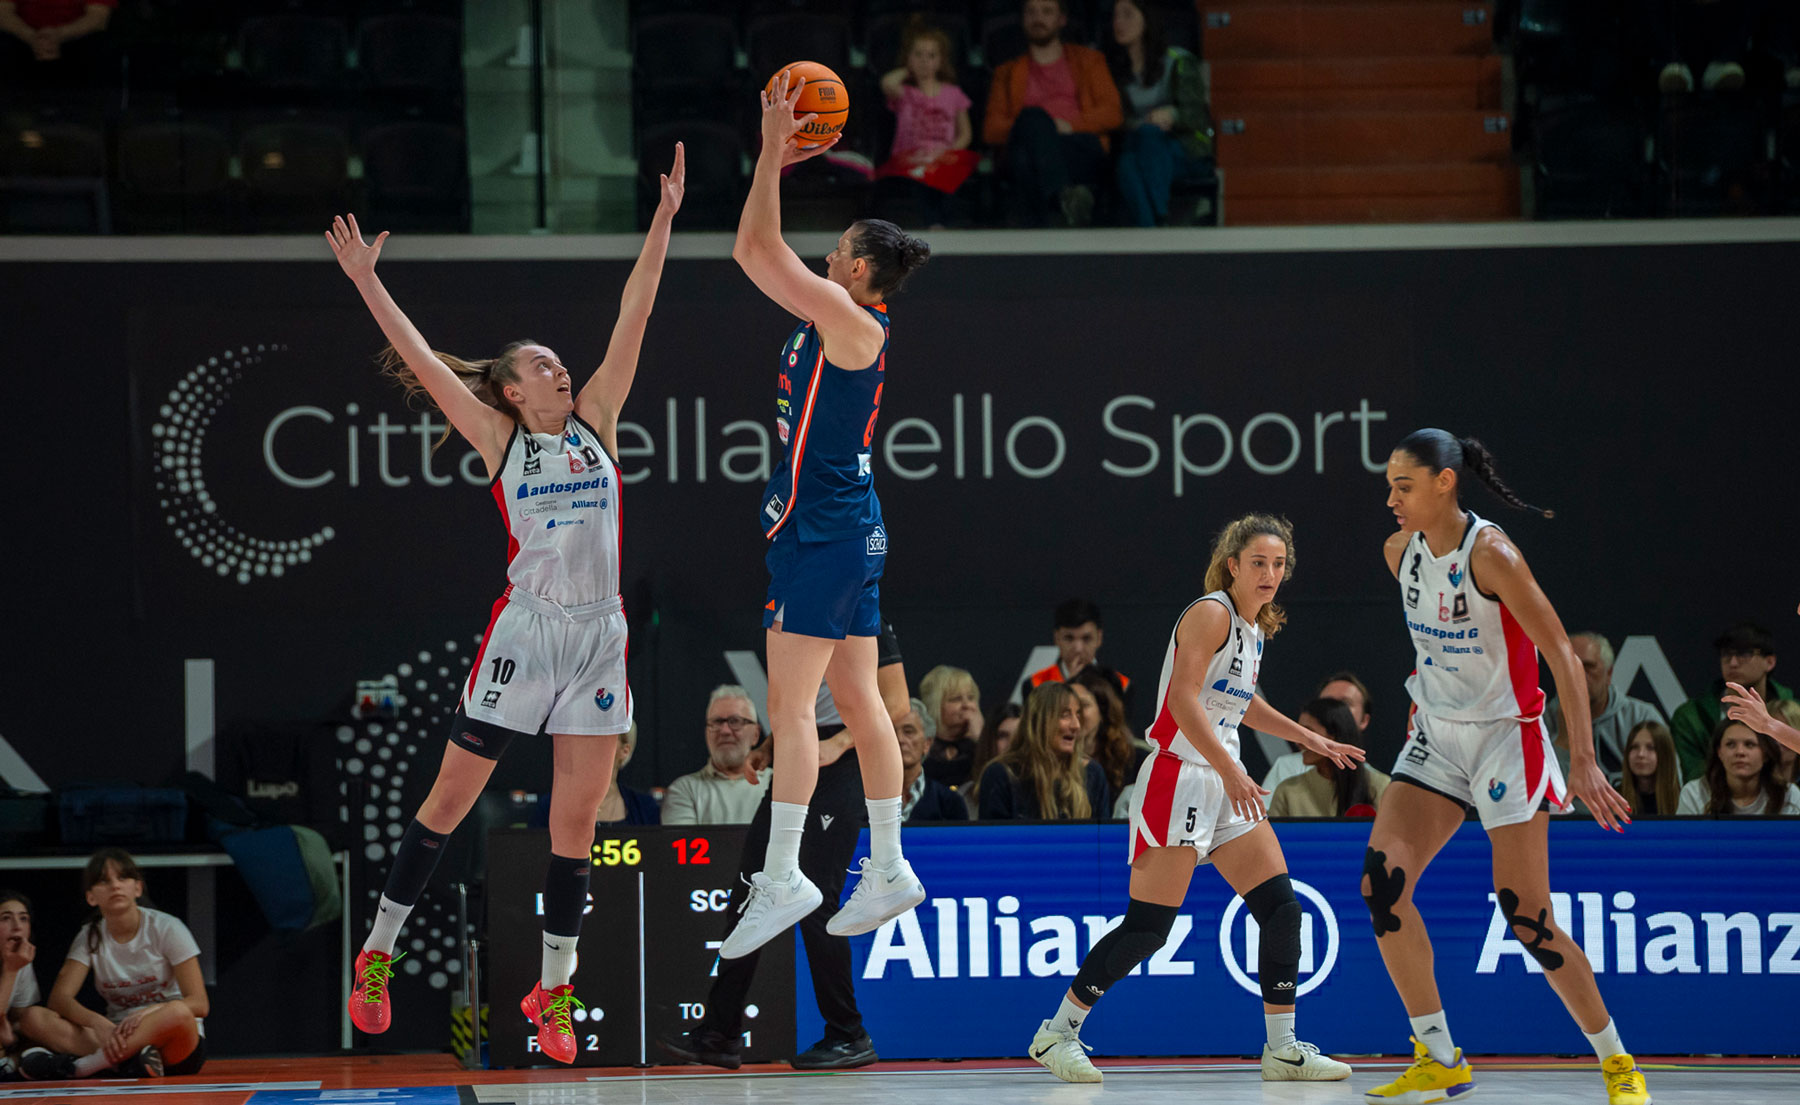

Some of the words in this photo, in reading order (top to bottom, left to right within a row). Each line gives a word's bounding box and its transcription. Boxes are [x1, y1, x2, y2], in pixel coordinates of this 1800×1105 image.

[262, 397, 772, 489] Cittella
[883, 393, 1067, 481] ello
[1102, 395, 1389, 497] Sport
[530, 477, 600, 497] autosped
[601, 476, 609, 489] G
[571, 500, 598, 509] Allianz
[1408, 620, 1465, 640] autosped
[1468, 628, 1479, 638] G
[1442, 645, 1471, 654] Allianz
[491, 656, 516, 686] 10
[1226, 686, 1254, 702] autosp
[1185, 806, 1198, 833] 5
[590, 839, 642, 866] :56
[671, 837, 711, 865] 12
[690, 888, 733, 912] SC
[678, 1003, 706, 1020] TO
[585, 1034, 599, 1051] 2
[741, 1031, 752, 1048] 1
